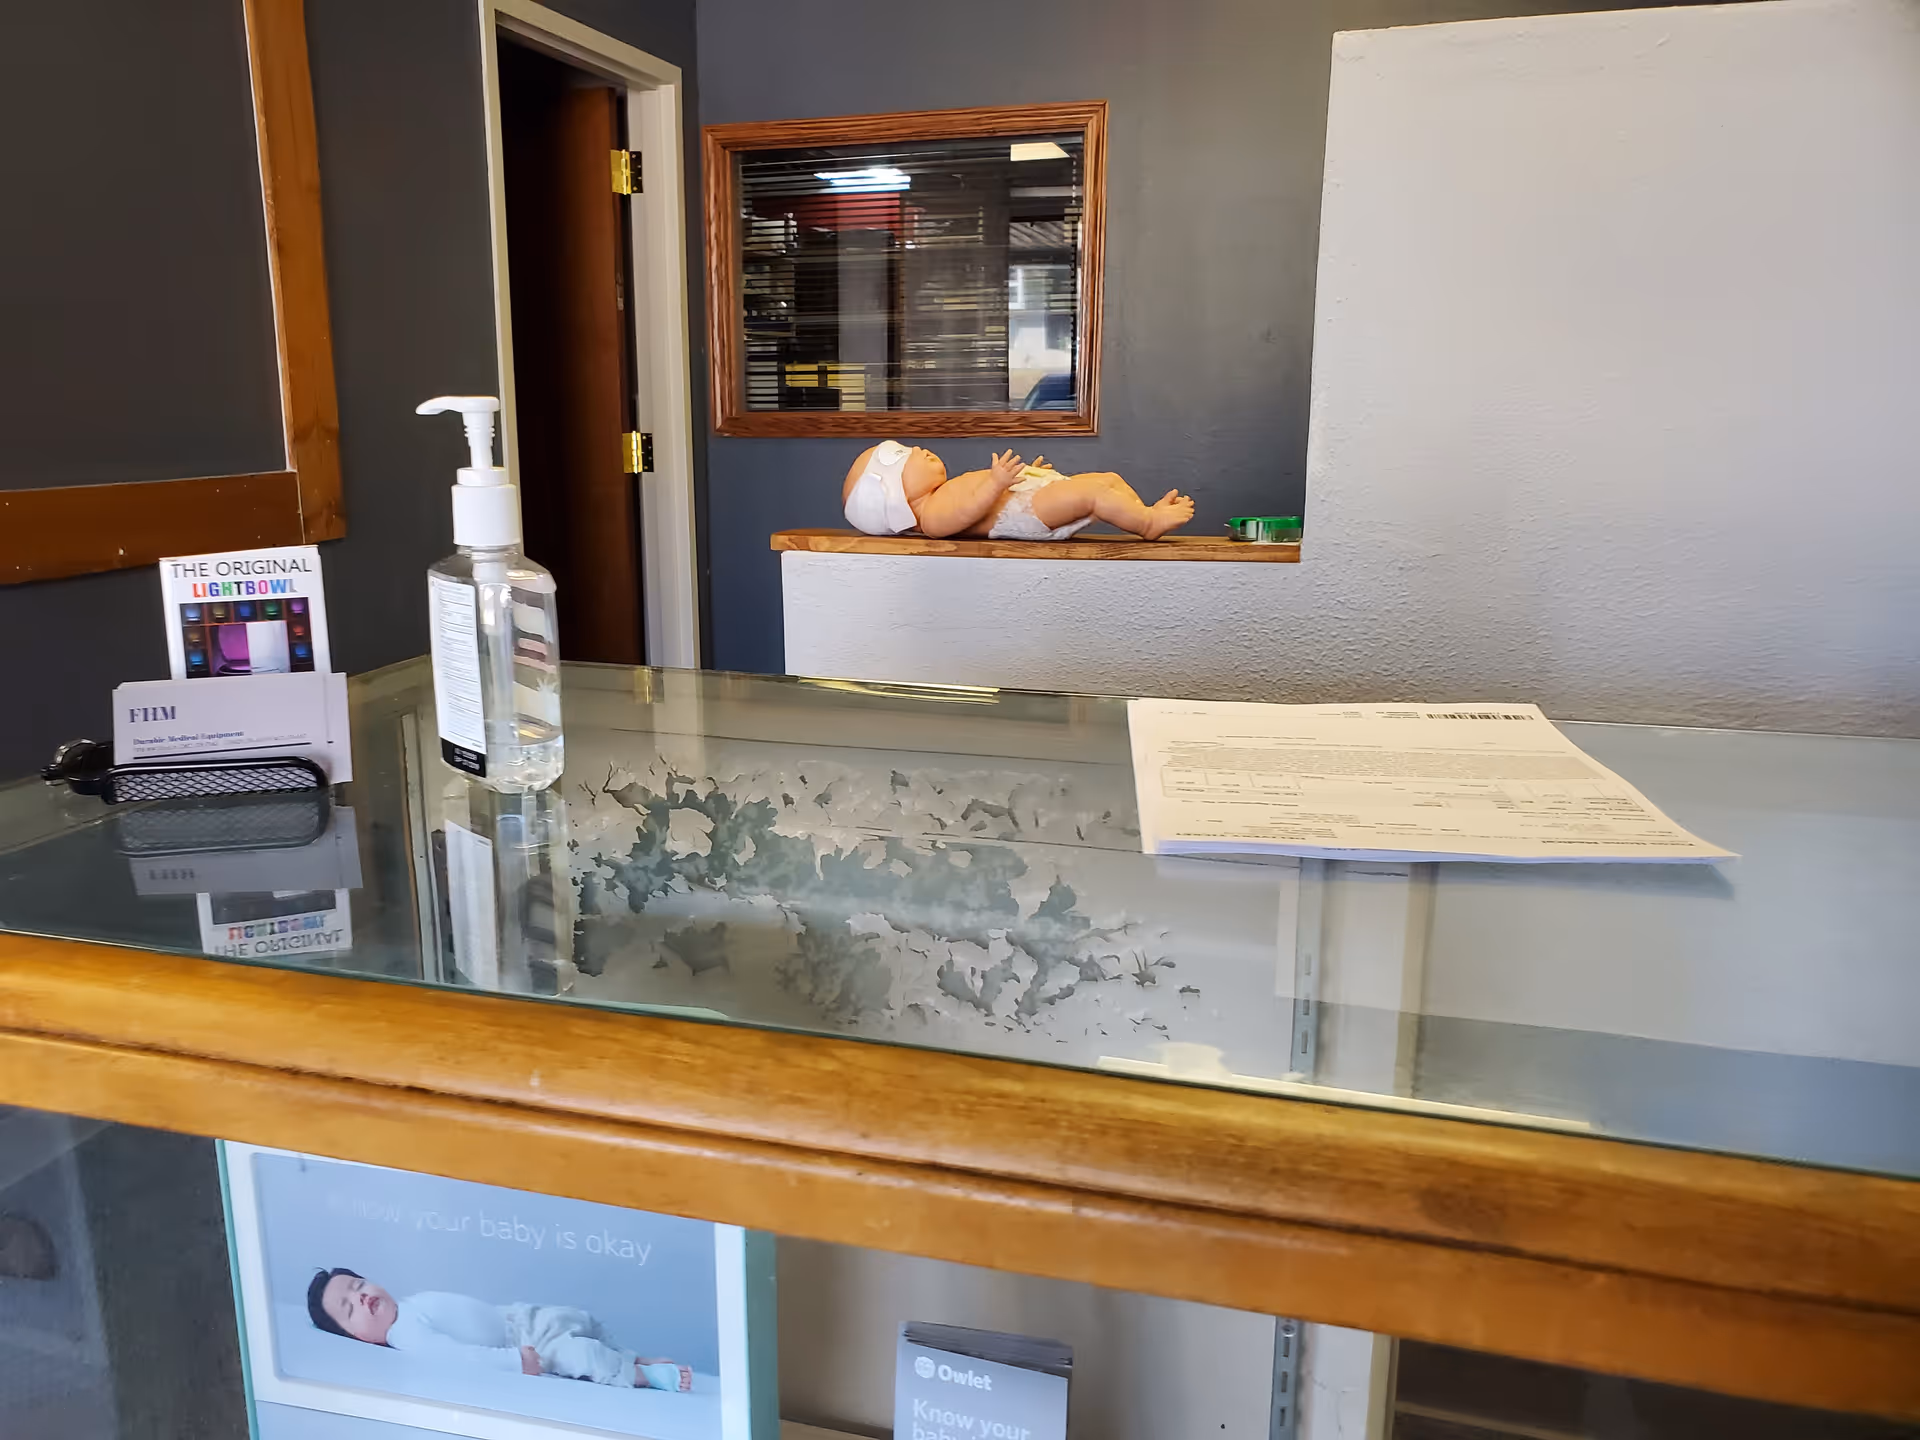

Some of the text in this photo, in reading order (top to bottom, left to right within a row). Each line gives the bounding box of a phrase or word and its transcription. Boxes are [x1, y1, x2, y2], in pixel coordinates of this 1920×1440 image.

[171, 558, 312, 578] THE ORIGINAL
[192, 579, 298, 598] LIGHTBOWL
[479, 1211, 547, 1250] baby
[556, 1223, 577, 1250] is
[585, 1231, 653, 1267] okay
[938, 1364, 993, 1391] Owlet
[912, 1398, 1031, 1440] Know your
